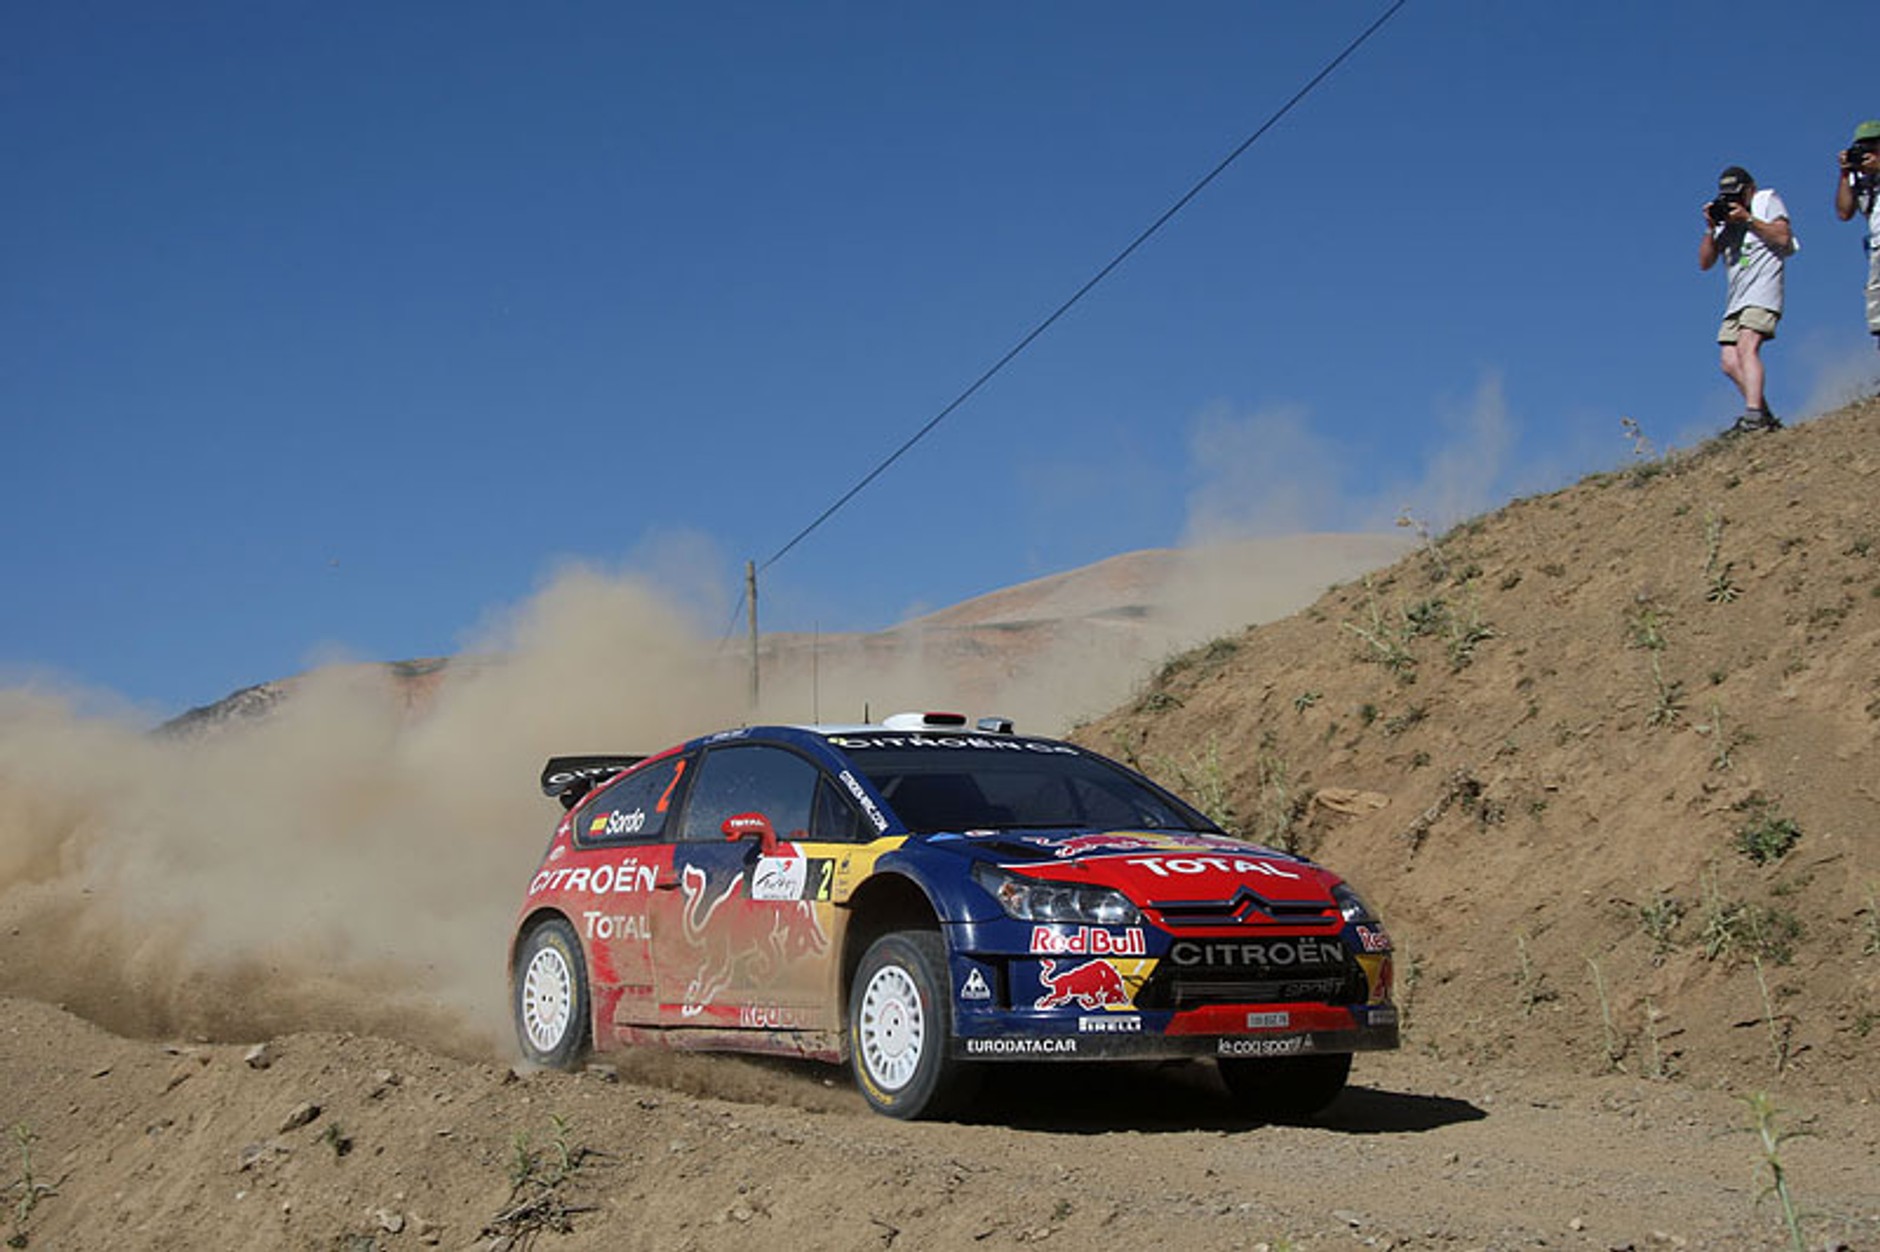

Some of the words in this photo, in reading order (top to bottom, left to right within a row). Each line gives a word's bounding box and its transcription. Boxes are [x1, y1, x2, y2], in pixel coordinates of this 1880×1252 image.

[606, 807, 646, 835] Sordo
[730, 818, 766, 828] TOTAL
[529, 858, 660, 896] CITROËN
[817, 859, 834, 900] 2
[1126, 857, 1300, 880] TOTAL
[583, 910, 651, 940] TOTAL
[1030, 926, 1088, 953] Red
[1090, 928, 1146, 954] Bull
[1170, 937, 1344, 966] CITROËN
[1078, 1016, 1141, 1032] PIRELLI
[966, 1039, 1077, 1052] EURODATACAR
[1234, 1040, 1261, 1056] coq
